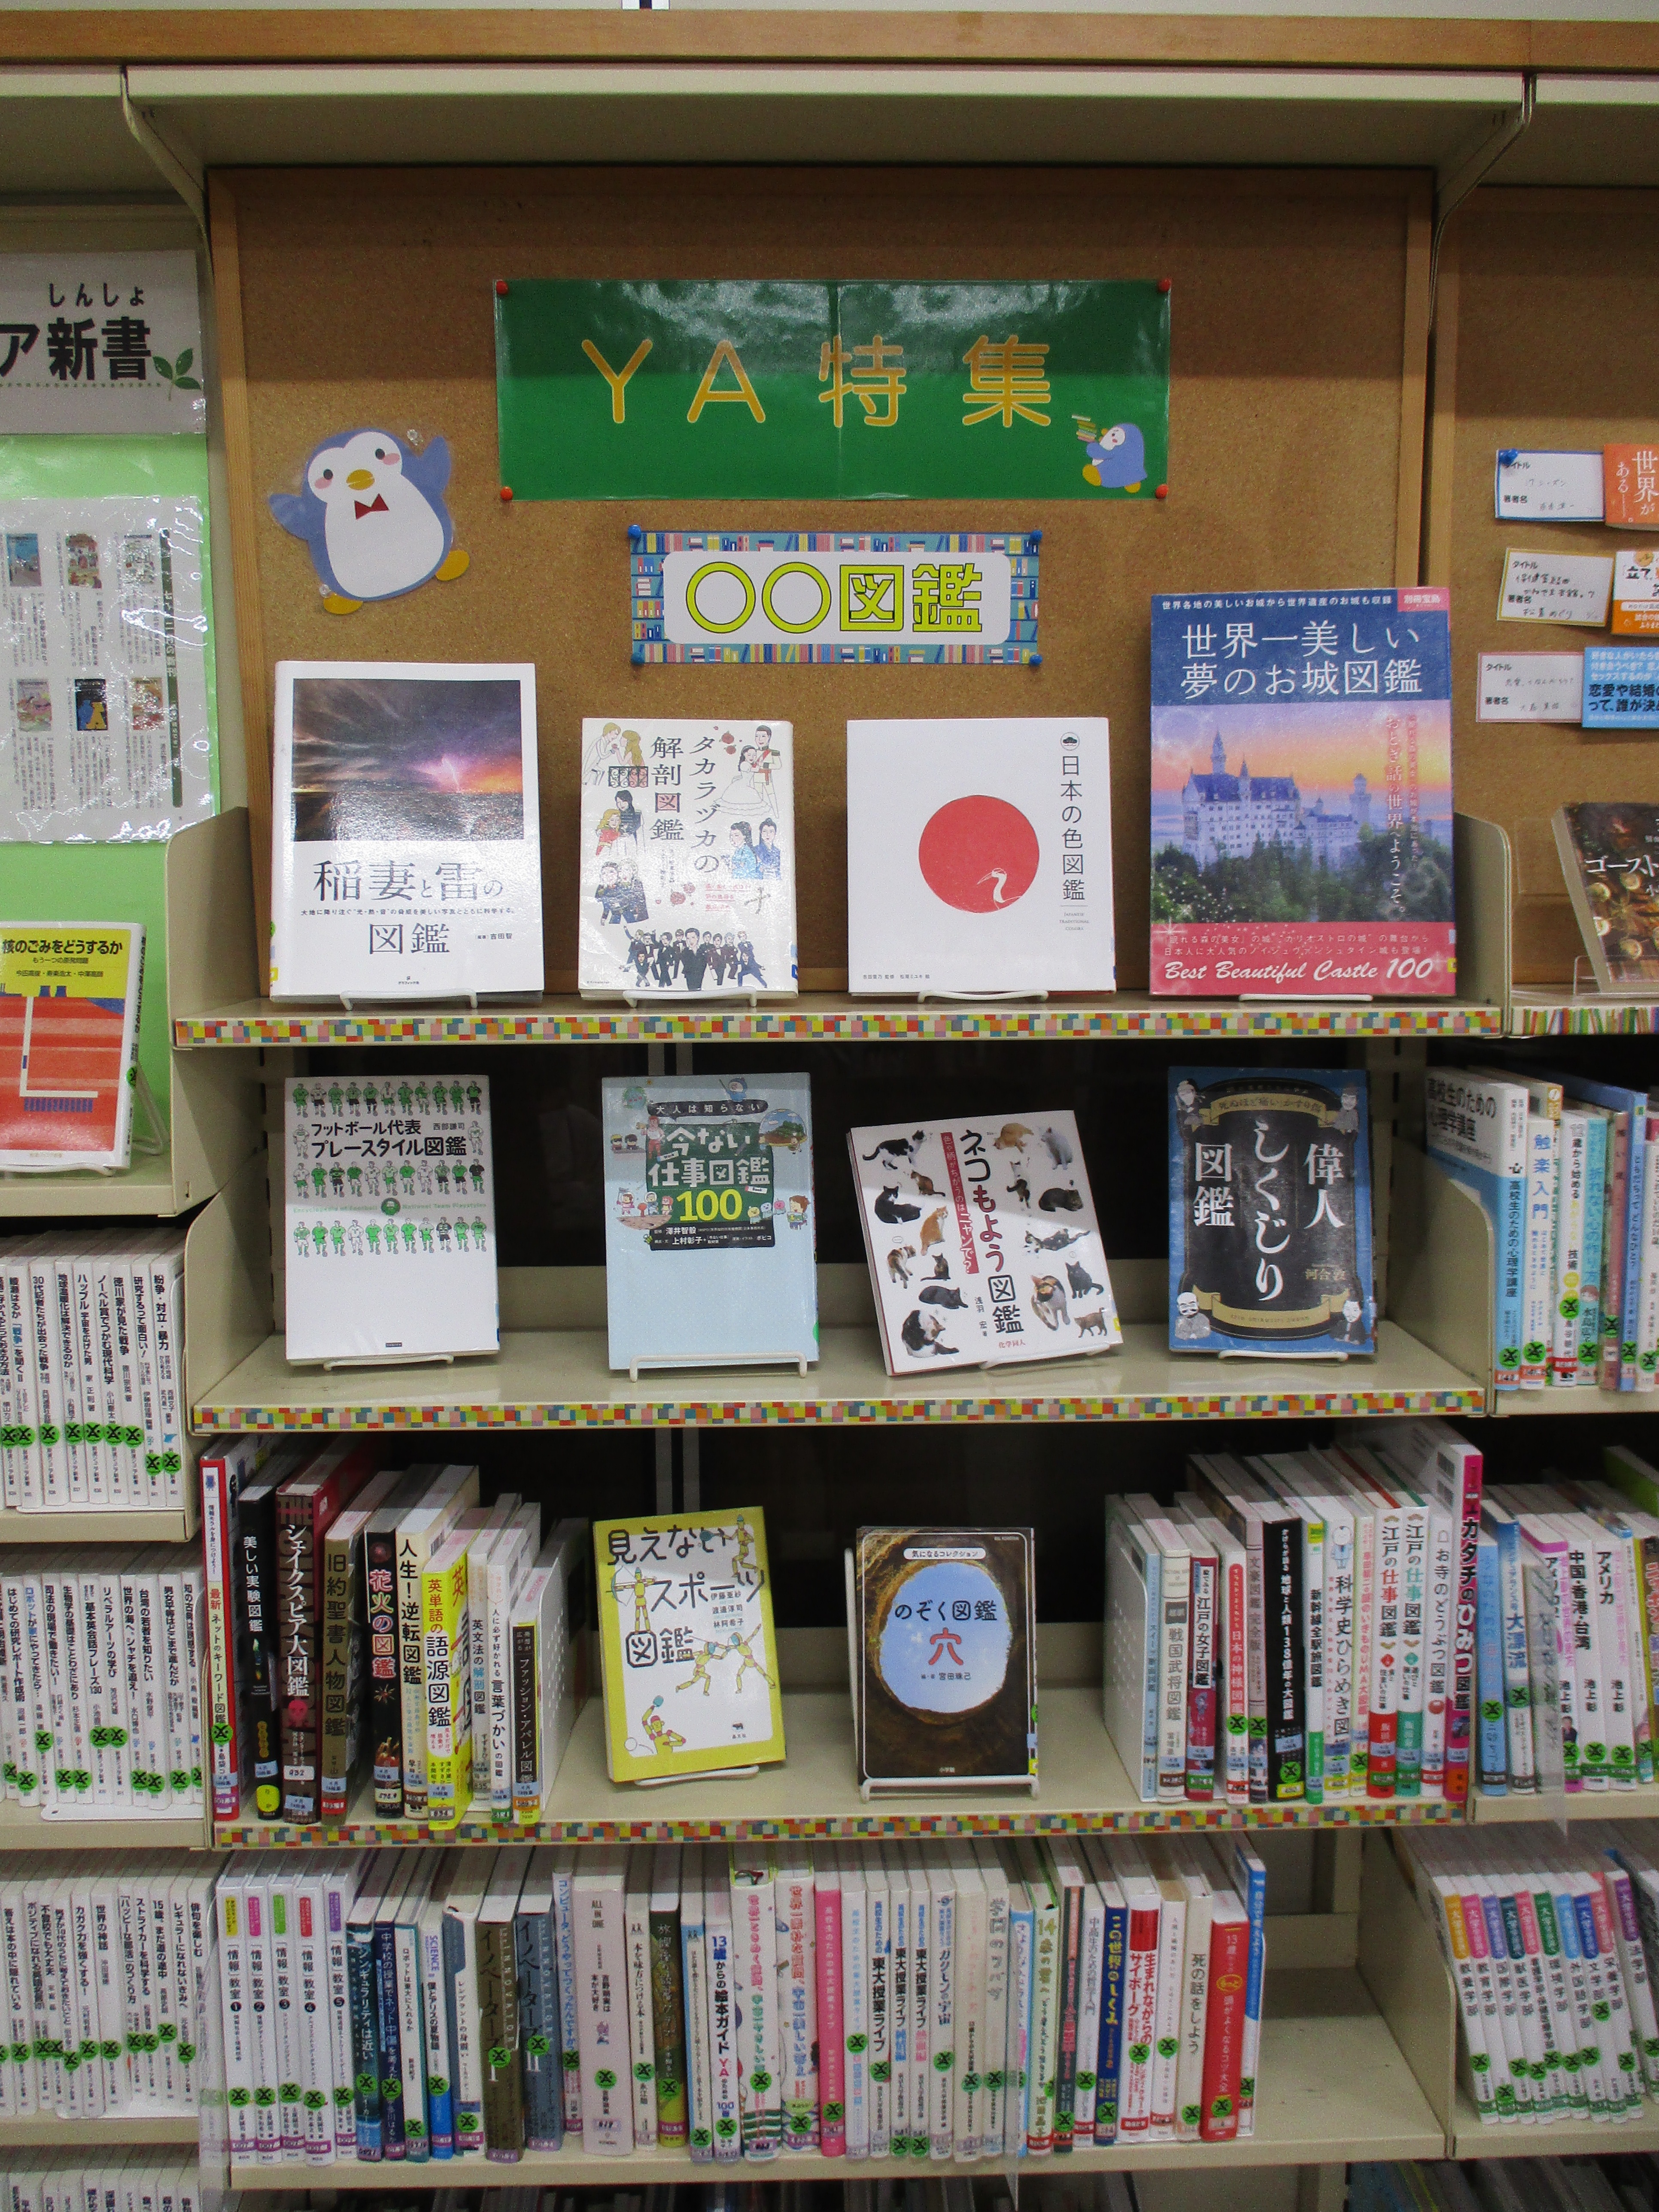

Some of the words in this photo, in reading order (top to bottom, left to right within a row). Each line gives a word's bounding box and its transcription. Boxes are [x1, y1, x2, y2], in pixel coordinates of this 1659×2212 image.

[49, 283, 145, 307] しんしょ
[1632, 451, 1659, 516] 世界が
[1513, 560, 1538, 569] タイトル
[1182, 620, 1419, 659] 世界一美しい
[1180, 659, 1422, 699] 夢のお城図鑑
[649, 736, 684, 842] 解剖図鑑
[688, 736, 719, 874] タカラヅカの
[1060, 755, 1085, 900] 日本の色図鑑
[313, 860, 503, 902] 稲妻と雷の
[2, 939, 123, 954] 核のごみをどうするか
[369, 923, 450, 955] 図鑑
[1164, 961, 1207, 980] Best
[1215, 961, 1307, 984] Beautiful
[1313, 960, 1379, 981] Castle
[1386, 957, 1432, 978] 100
[311, 1120, 421, 1136] フットボール代表
[312, 1136, 467, 1158] プレースタイル図鑑
[656, 1104, 761, 1114] 大人は知らない
[666, 1127, 751, 1156] 今ない
[648, 1157, 770, 1187] 仕事図鑑
[677, 1189, 743, 1221] 100
[1194, 1142, 1235, 1227] 図鑑
[1254, 1120, 1290, 1301] しくじり
[1304, 1143, 1346, 1229] 偉人
[1532, 1134, 1551, 1220] 触楽入門
[960, 1129, 1024, 1334] ネコもよう図鑑
[114, 1277, 129, 1355] 徳川家が見た戦争
[154, 1275, 169, 1351] 紛争・対立・暴力
[608, 1525, 726, 1565] 見えない
[1380, 1524, 1400, 1637] 江戸の仕事図鑑
[1404, 1524, 1423, 1635] 江戸の仕事図鑑
[1597, 1551, 1615, 1605] アメリカ
[243, 1536, 262, 1632] 美しい実験図鑑
[286, 1525, 310, 1696] シェイクスピア大図鑑
[651, 1570, 766, 1612] スポーツ
[895, 1600, 997, 1621] のぞく図鑑
[1570, 1550, 1591, 1650] 中国・香港・台湾
[324, 1553, 346, 1735] 旧約聖書人物図鑑
[370, 1570, 395, 1679] 花火の図鑑
[626, 1626, 695, 1668] 図鑑
[928, 1627, 964, 1665] 穴
[1195, 1597, 1210, 1686] 江戸の女子図鑑
[1335, 1575, 1354, 1743] 科学史ひらめき図
[472, 1620, 486, 1714] 英文法の解剖図鑑
[1167, 1628, 1183, 1721] 戦国武将図鑑
[429, 1936, 439, 1971] SCIENCE
[895, 1948, 907, 2028] 東大授業ライブ
[916, 1948, 927, 2028] 東大授業ライブ
[1128, 1954, 1142, 2014] サイボーグ
[872, 1957, 886, 2052] 東大授業ライブ
[1188, 1954, 1206, 2054] 死の話をしよう
